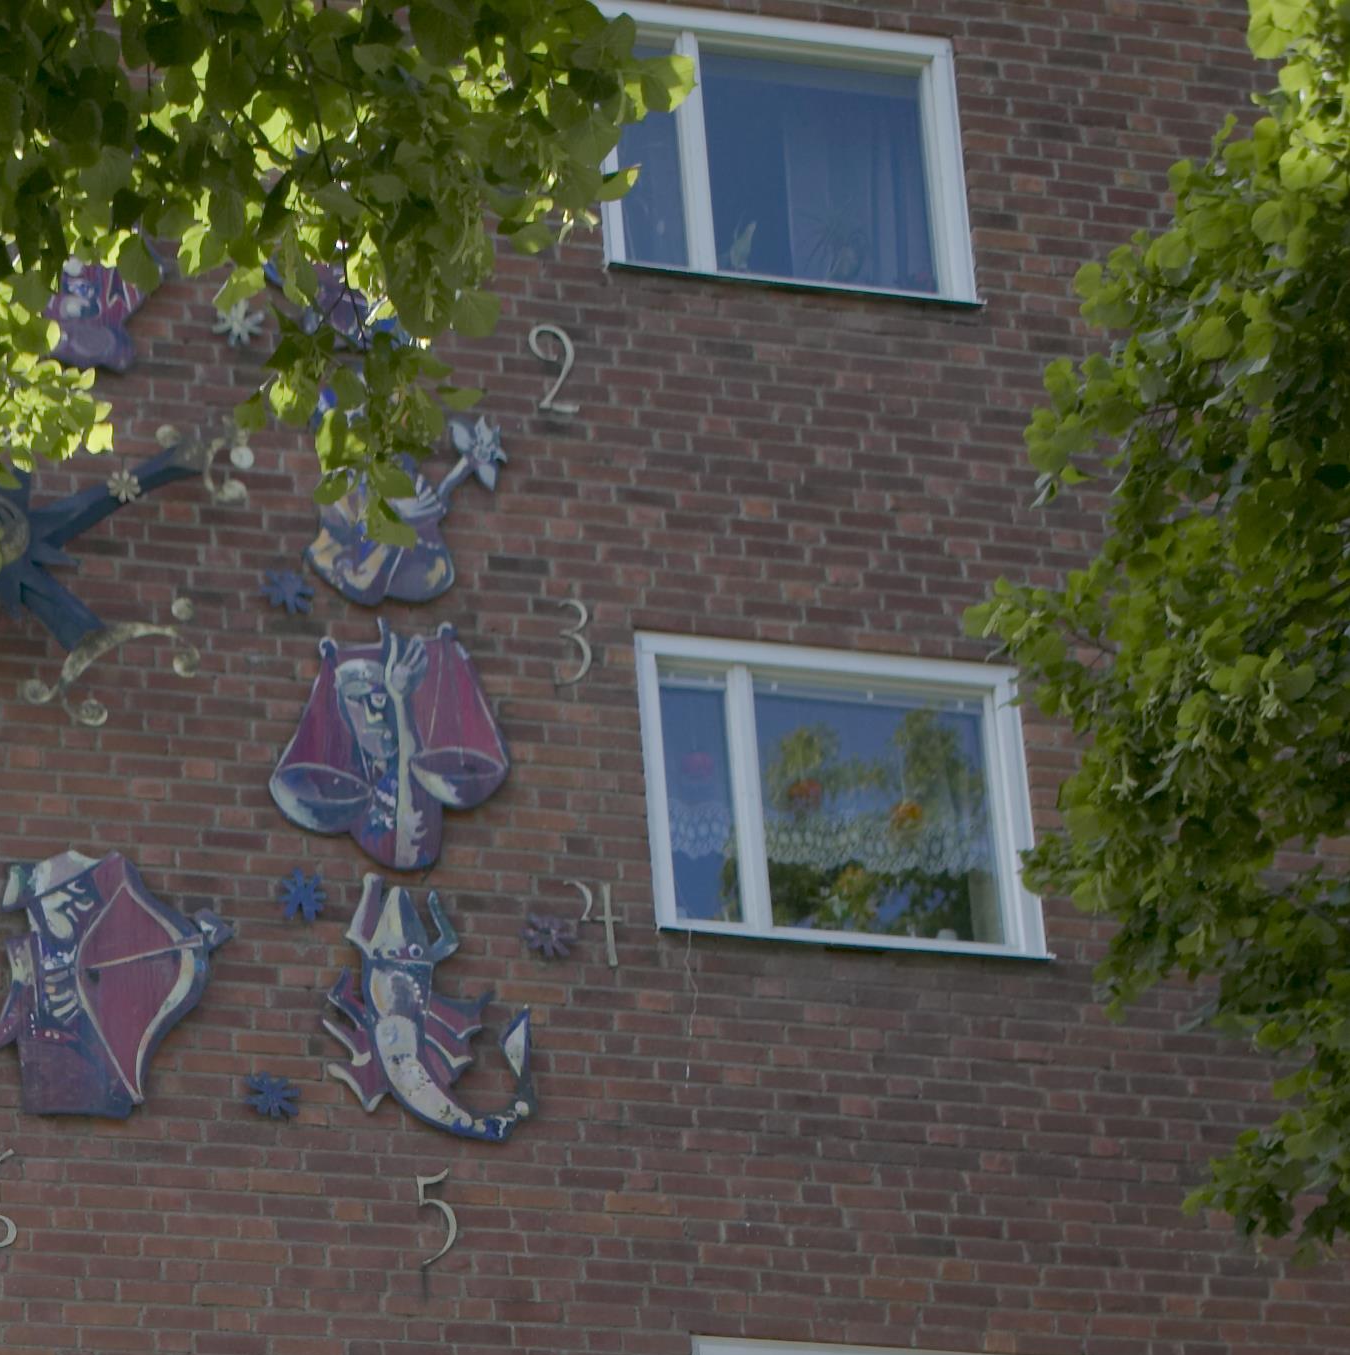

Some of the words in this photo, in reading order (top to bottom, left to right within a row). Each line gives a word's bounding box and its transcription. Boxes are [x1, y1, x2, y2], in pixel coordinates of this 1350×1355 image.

[527, 323, 581, 416] 2
[558, 598, 593, 687] 3
[563, 879, 624, 967] 4
[416, 1167, 458, 1267] 5
